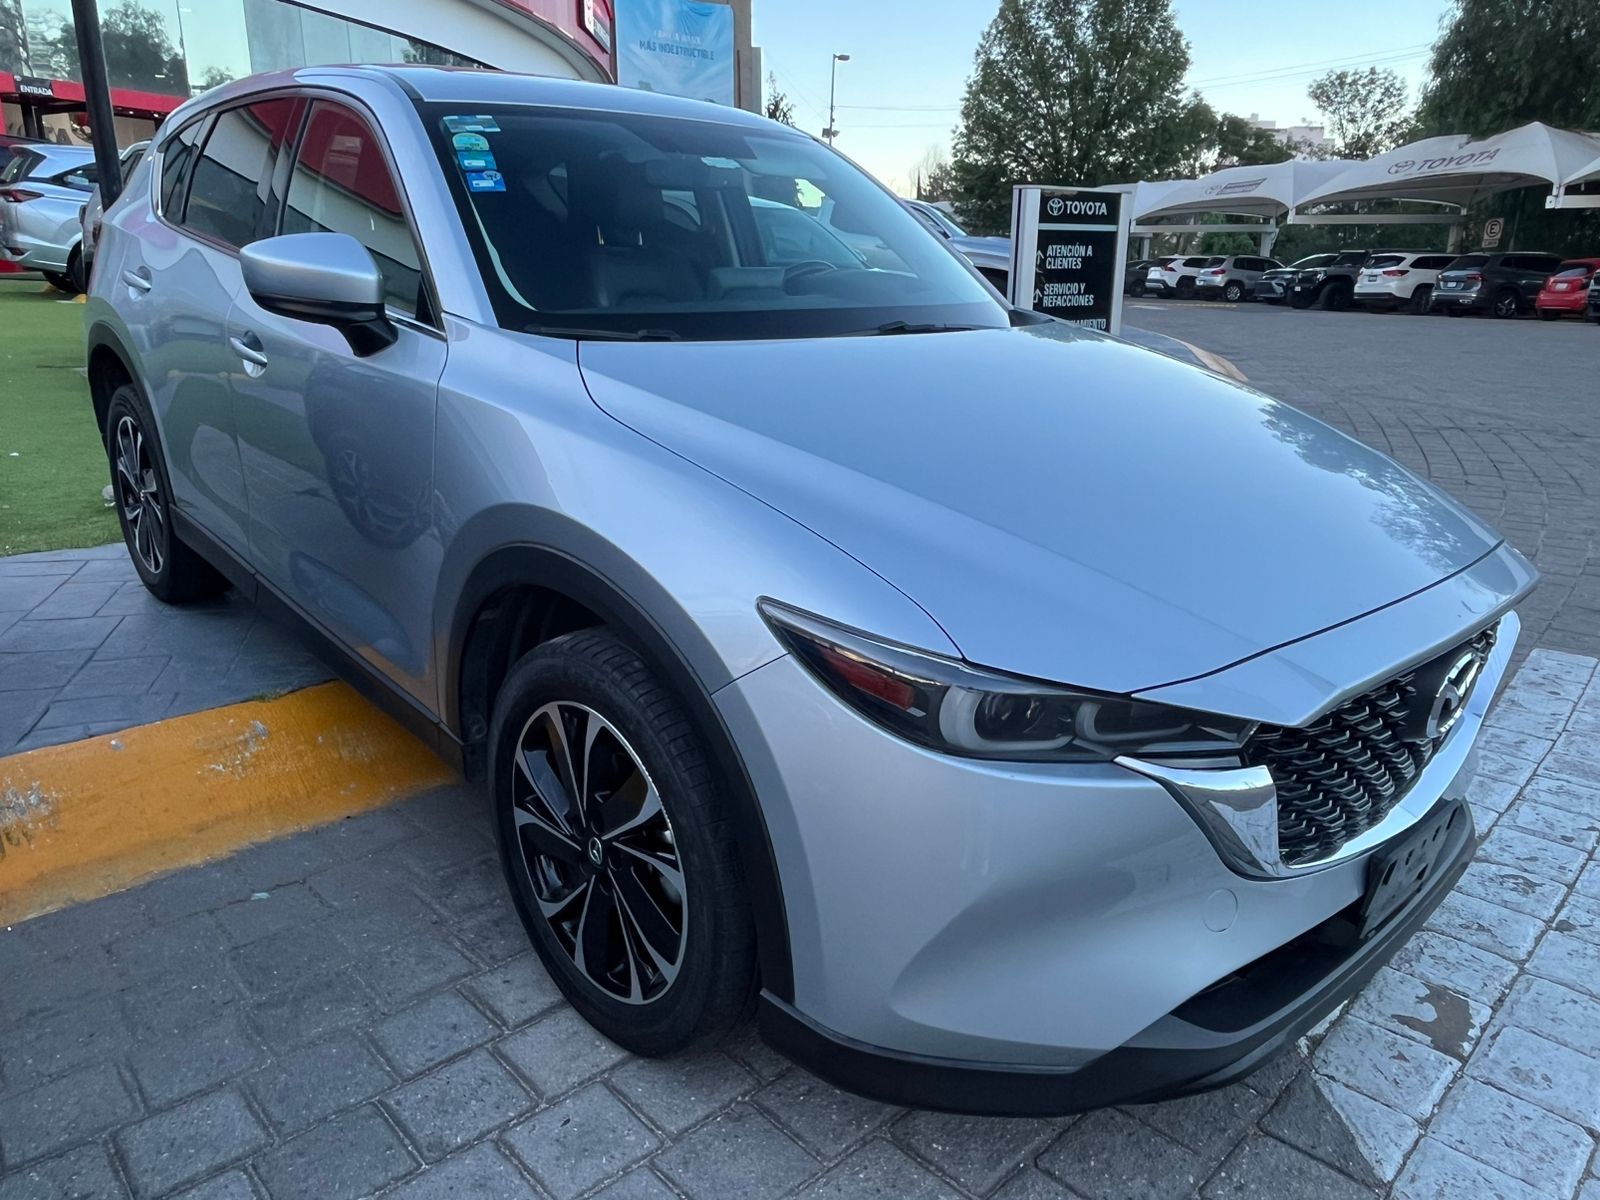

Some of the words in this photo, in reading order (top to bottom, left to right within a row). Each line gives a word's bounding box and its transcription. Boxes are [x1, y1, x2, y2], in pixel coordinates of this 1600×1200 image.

[20, 85, 53, 96] ENTRADA
[1417, 148, 1501, 171] TOYOTA
[1065, 201, 1108, 216] TOYOTA
[1046, 242, 1086, 257] ATENCIÓN
[1086, 245, 1093, 257] A
[1046, 257, 1082, 270] CLIENTES
[1043, 283, 1079, 295] SERVICIO
[1079, 282, 1086, 294] Y
[1042, 294, 1095, 308] REFACCIONES
